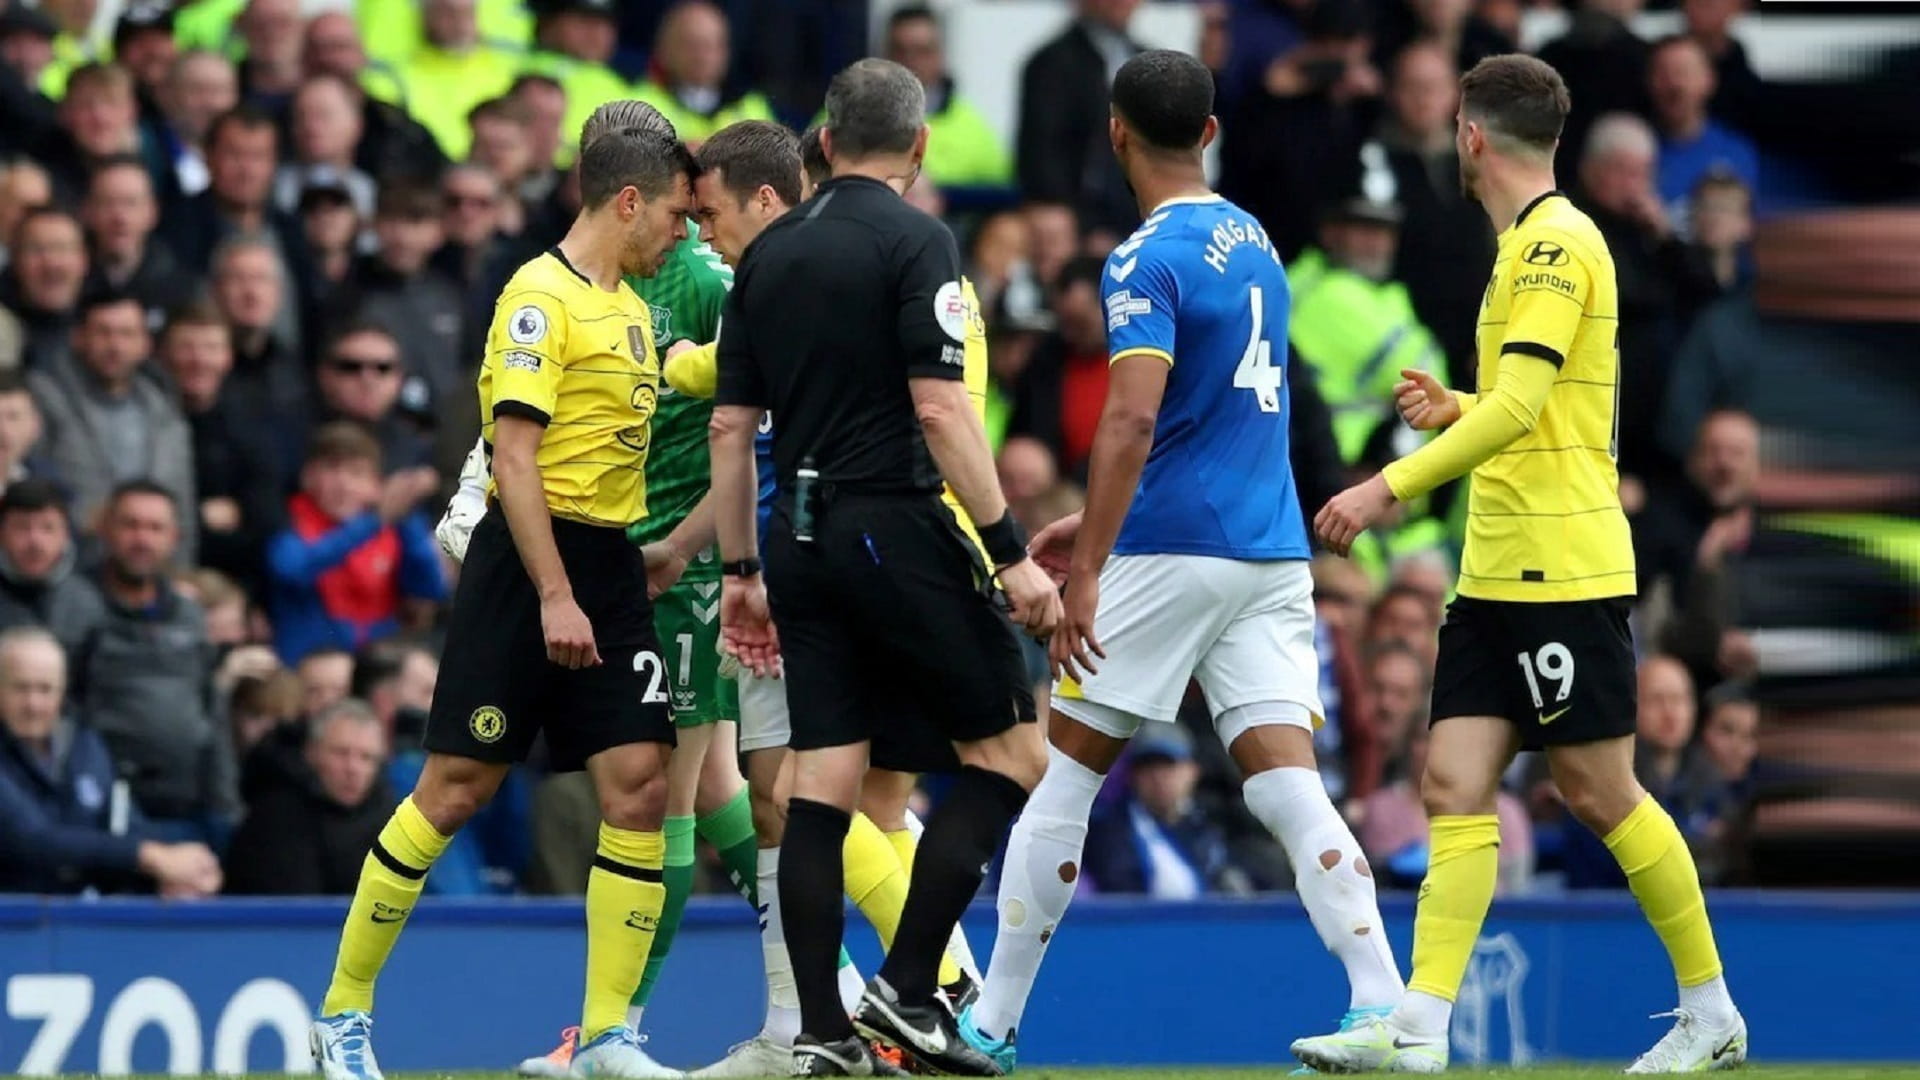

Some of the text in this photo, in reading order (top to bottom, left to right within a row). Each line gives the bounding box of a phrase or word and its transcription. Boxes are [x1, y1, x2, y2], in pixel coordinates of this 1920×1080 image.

[1514, 272, 1578, 295] HYUNDAI
[1233, 286, 1281, 413] 4
[633, 650, 672, 704] 2
[676, 633, 693, 686] 1
[1518, 641, 1575, 708] 19
